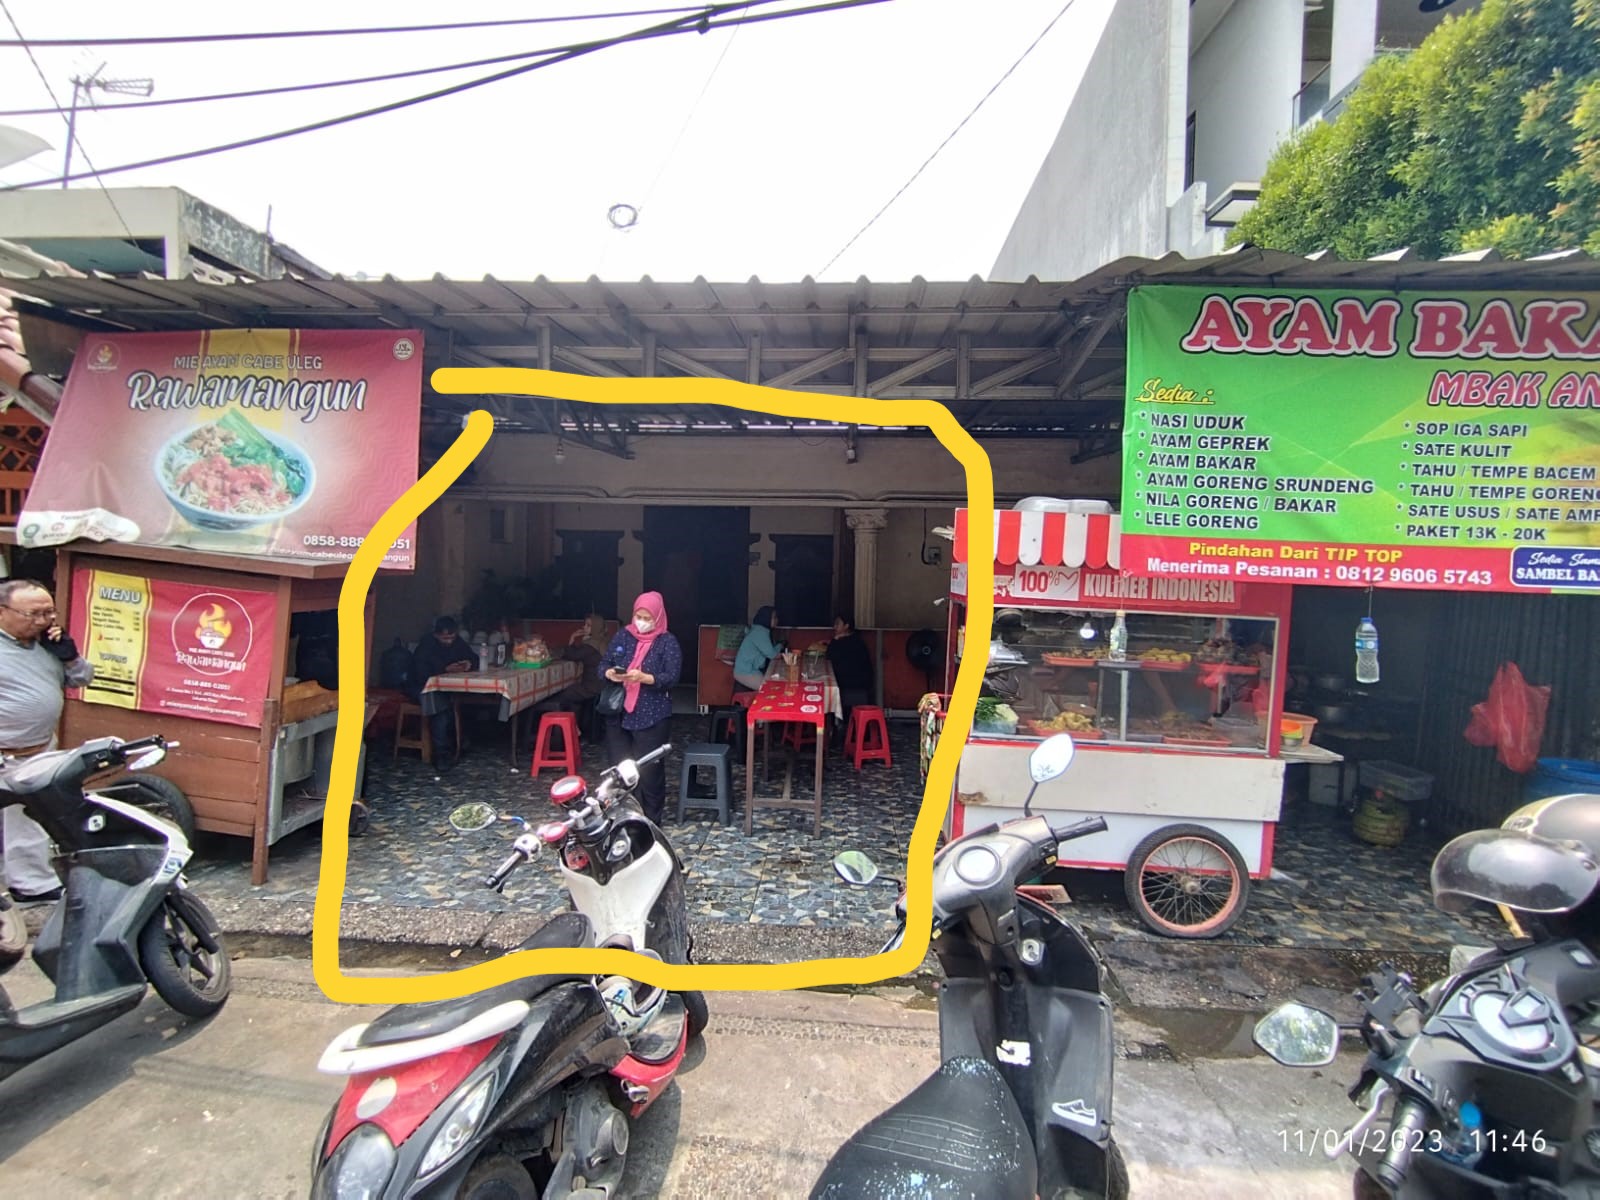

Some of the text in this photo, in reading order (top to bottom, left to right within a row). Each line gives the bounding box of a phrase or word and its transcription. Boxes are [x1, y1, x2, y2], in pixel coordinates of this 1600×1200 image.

[1181, 295, 1402, 358] AYAM
[174, 354, 323, 369] MIE AYAM CABE ULEG
[127, 369, 368, 423] Rawamangun
[1137, 377, 1198, 404] Sedia
[1427, 370, 1547, 407] MBAK
[1151, 413, 1245, 430] NASI UDUK
[1416, 422, 1527, 437] SOP IGA SAPI
[1150, 433, 1271, 451] AYAM GEPREK
[1414, 443, 1512, 458] SATE KULIT
[1148, 452, 1257, 470] AYAM BAKAR
[1412, 463, 1456, 477] TAHU
[1471, 465, 1528, 479] TEMPE
[1534, 466, 1596, 480] BACEM
[1146, 472, 1374, 494] AYAM GORENG SRUNDENG
[1410, 484, 1454, 497] TAHU
[1469, 485, 1526, 499] TEMPE
[1146, 492, 1180, 507] NILA
[1186, 494, 1259, 510] GORENG
[1274, 497, 1337, 513] BAKAR
[1146, 511, 1259, 529] LELE GORENG
[1408, 504, 1449, 518] SATE
[1455, 505, 1500, 519] USUS
[1516, 507, 1560, 521] SATE
[1406, 524, 1460, 538] PAKET
[1466, 526, 1496, 539] 13K
[1513, 527, 1546, 540] 20K
[1189, 542, 1403, 563] Pindahan Dari TIP TOP
[1528, 552, 1564, 565] Sedia
[1147, 557, 1230, 575] Menerima
[1235, 561, 1318, 579] Pesanan
[1335, 564, 1383, 582] 0812
[1389, 566, 1438, 584] 9606
[1443, 569, 1492, 585] 5743
[1516, 567, 1575, 580] SAMBEL
[100, 587, 142, 604] MENU
[1084, 573, 1149, 600] KULINER
[1151, 578, 1235, 603] INDONESIA
